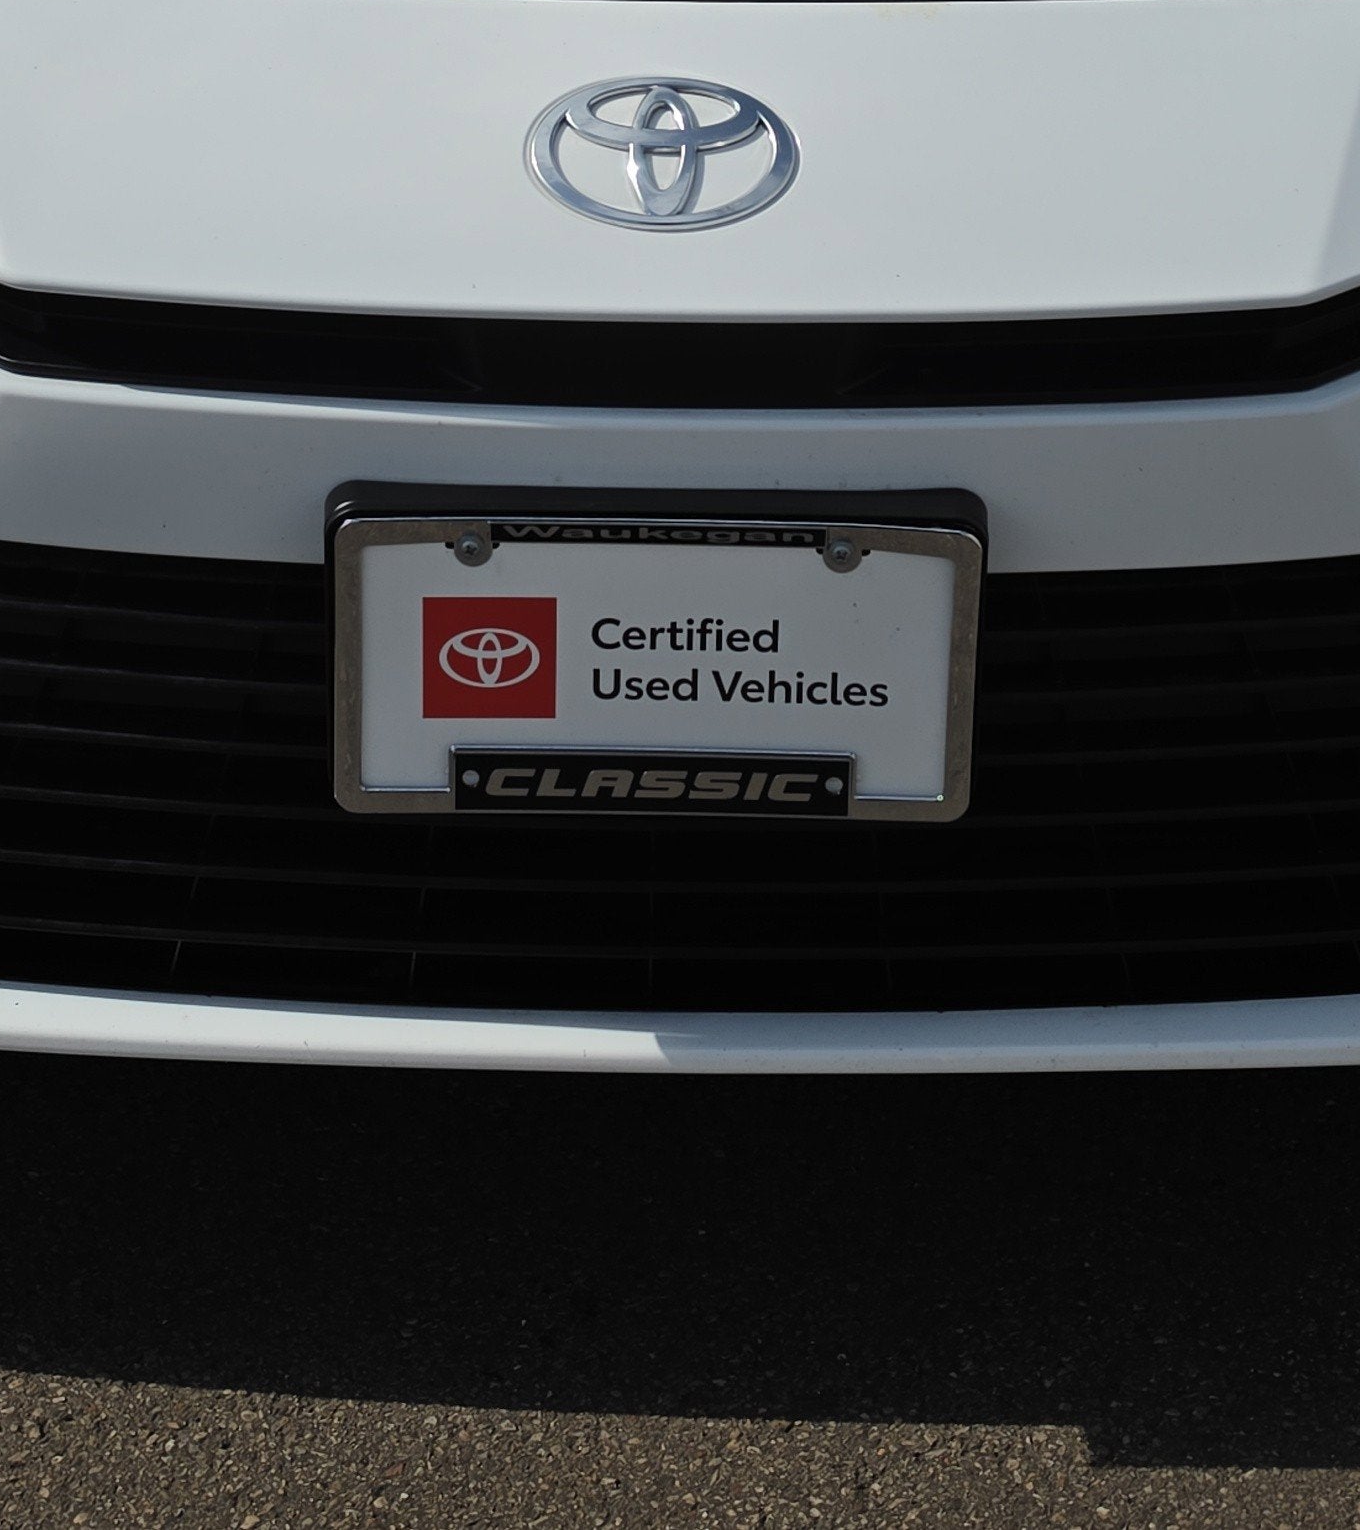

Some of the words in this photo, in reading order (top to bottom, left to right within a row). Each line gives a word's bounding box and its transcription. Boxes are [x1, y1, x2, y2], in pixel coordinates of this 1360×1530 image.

[502, 525, 814, 544] Waukegan
[591, 617, 779, 653] Certified
[592, 668, 699, 701] Used
[711, 670, 889, 707] Vehicles
[486, 768, 819, 802] CLASSIC
